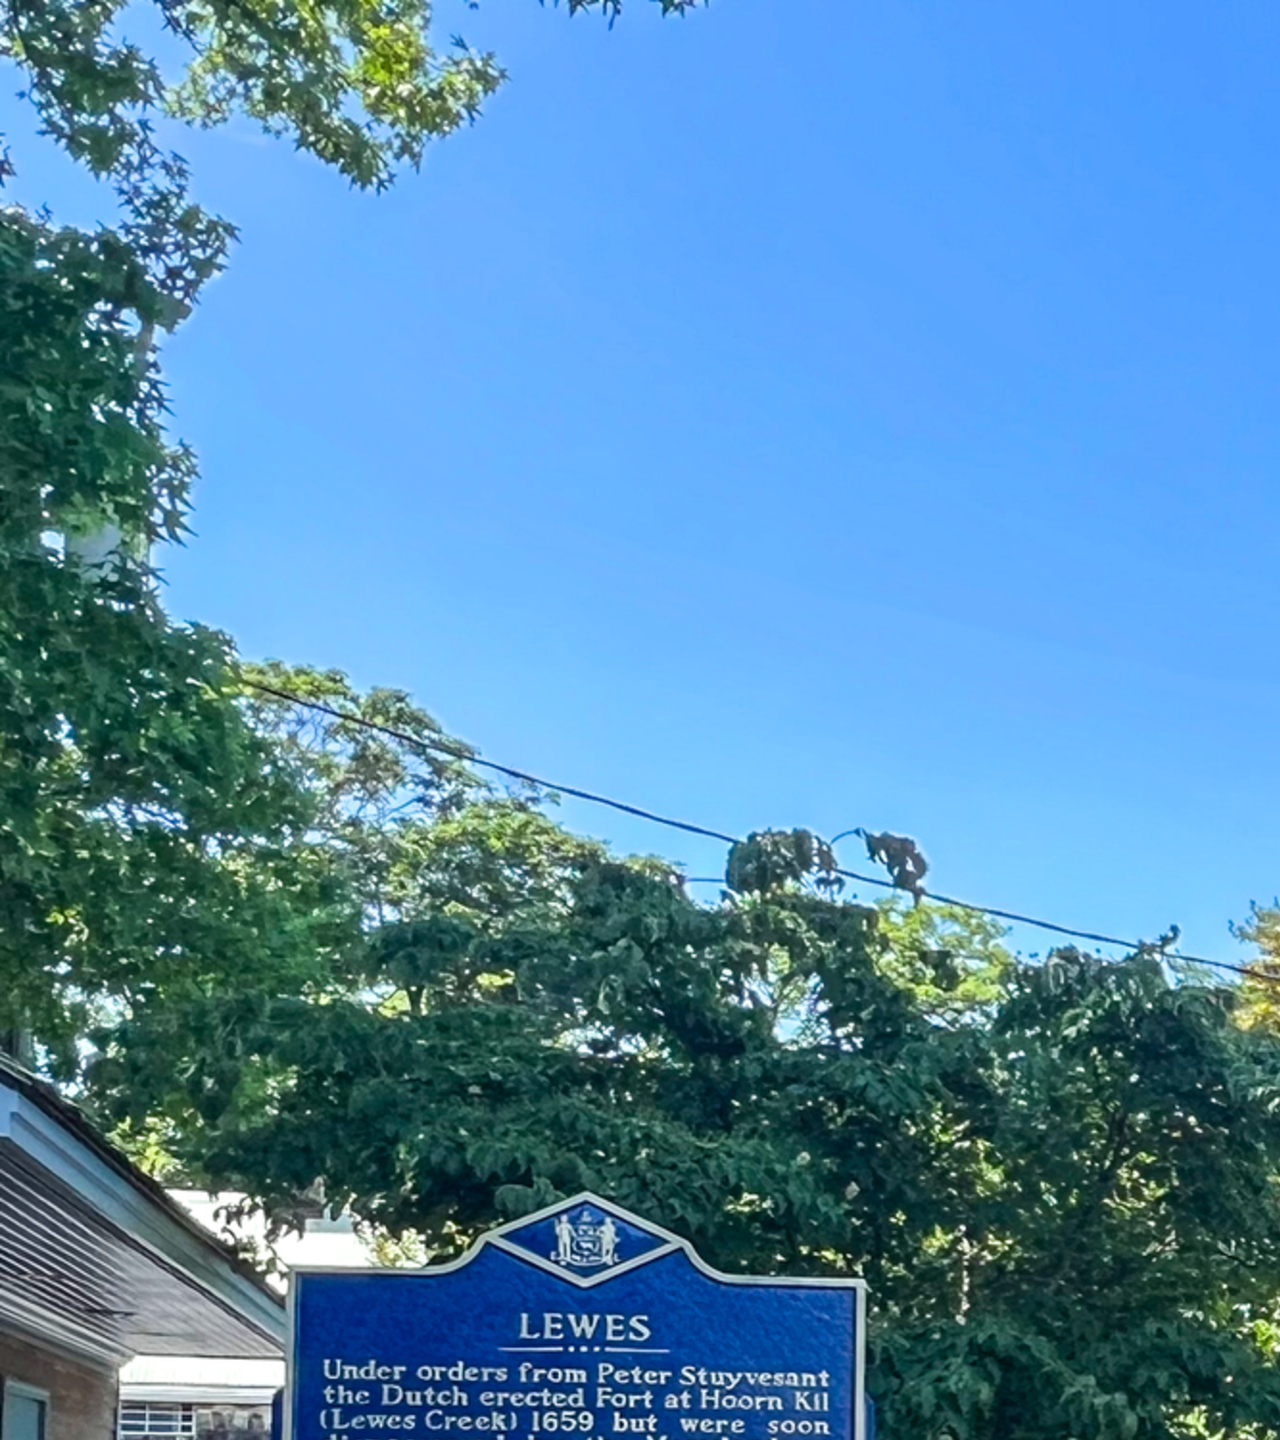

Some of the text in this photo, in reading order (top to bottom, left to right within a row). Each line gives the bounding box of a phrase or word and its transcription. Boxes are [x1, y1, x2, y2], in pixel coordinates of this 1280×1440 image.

[519, 1312, 651, 1342] LEWES
[323, 1358, 830, 1391] Under orders from Peter Stuyvesant
[323, 1384, 829, 1412] the Dutch erected Fort at Hoorn Kil
[320, 1408, 831, 1435] (Lewes Creek) 1659 but were soon
